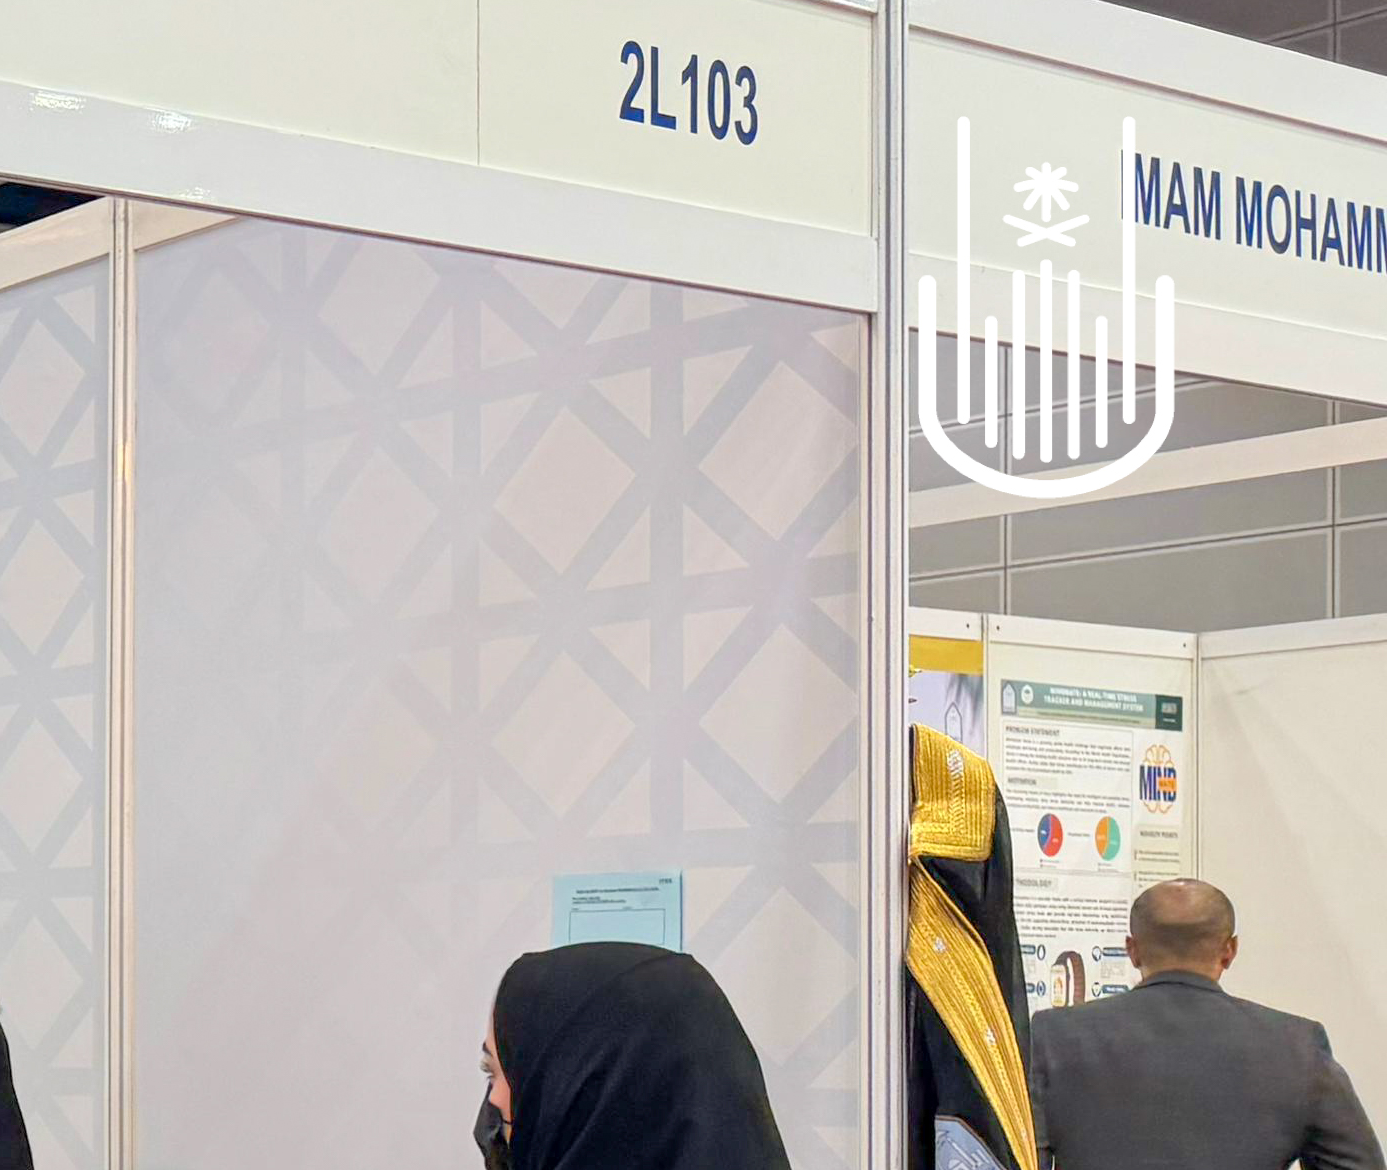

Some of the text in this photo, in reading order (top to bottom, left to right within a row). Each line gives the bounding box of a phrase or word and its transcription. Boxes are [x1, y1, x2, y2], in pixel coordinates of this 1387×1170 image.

[619, 40, 758, 146] 2L103
[1121, 150, 1221, 240] MAM
[1139, 765, 1177, 802] MIND
